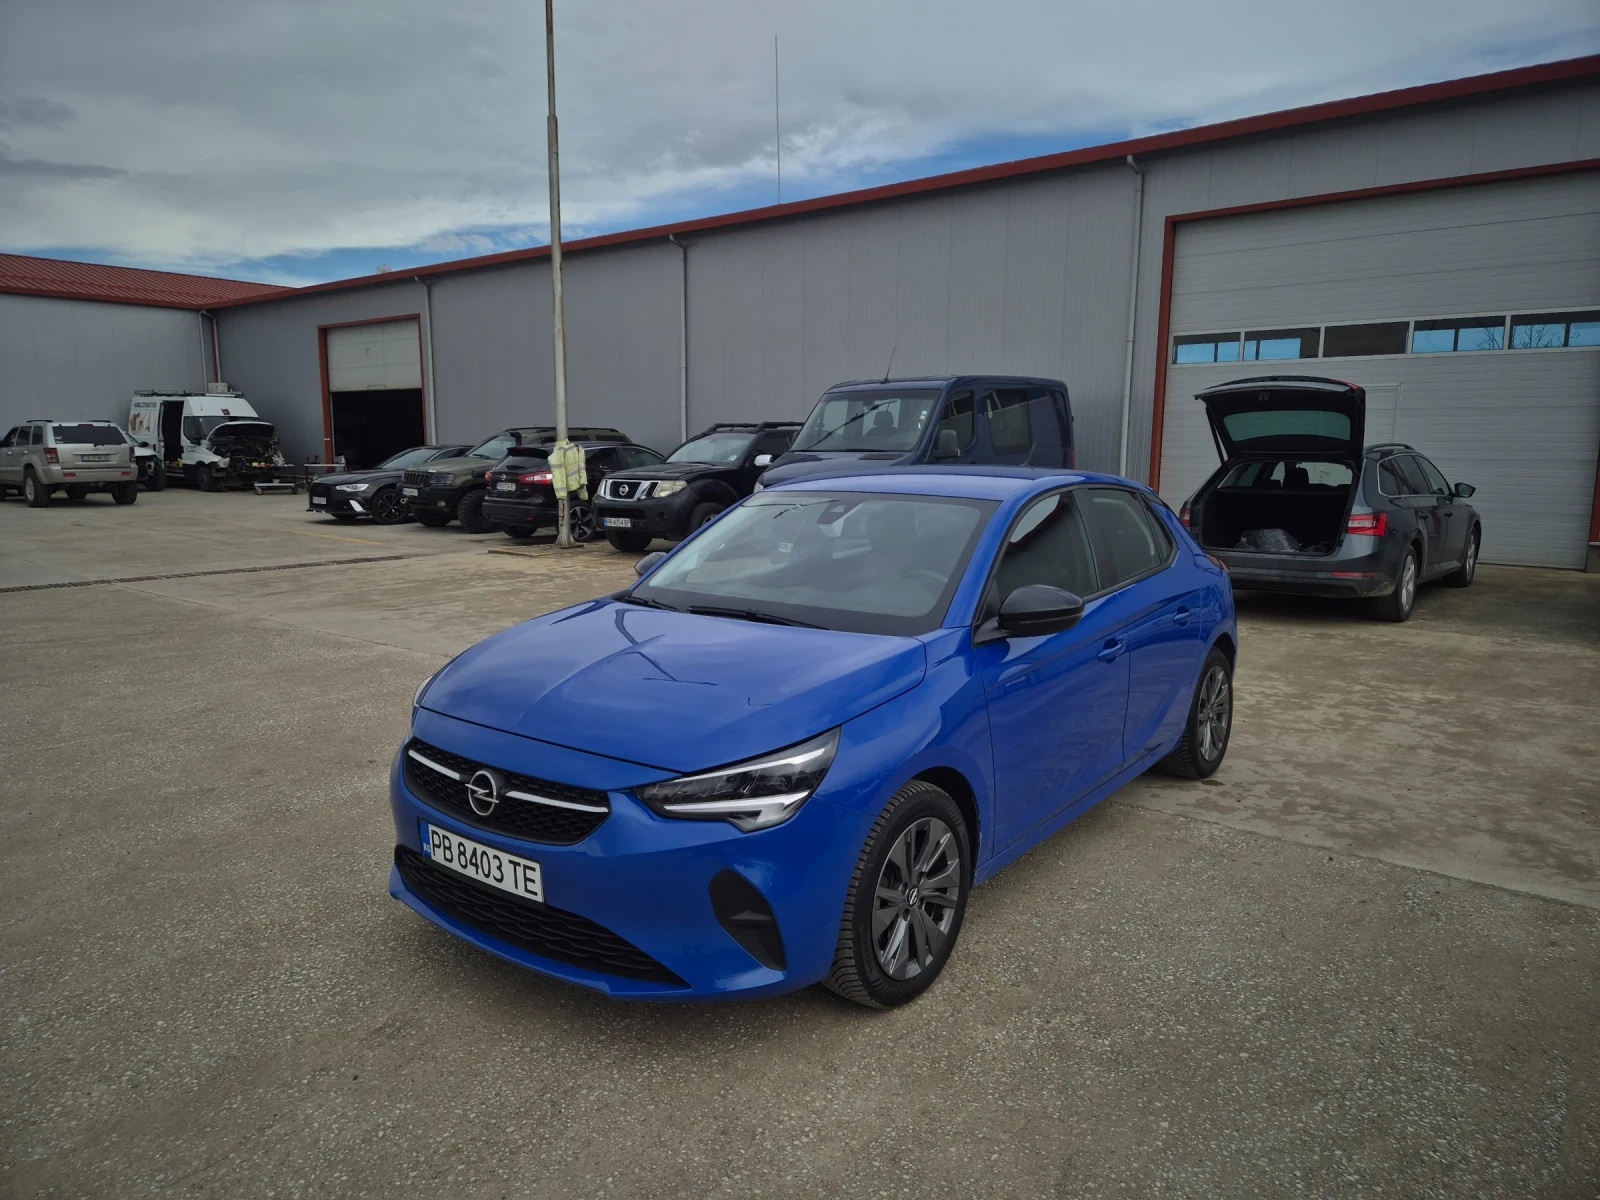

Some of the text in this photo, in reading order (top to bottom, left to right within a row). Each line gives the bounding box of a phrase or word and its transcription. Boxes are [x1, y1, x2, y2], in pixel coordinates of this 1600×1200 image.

[431, 829, 538, 897] PB 8403 TE
